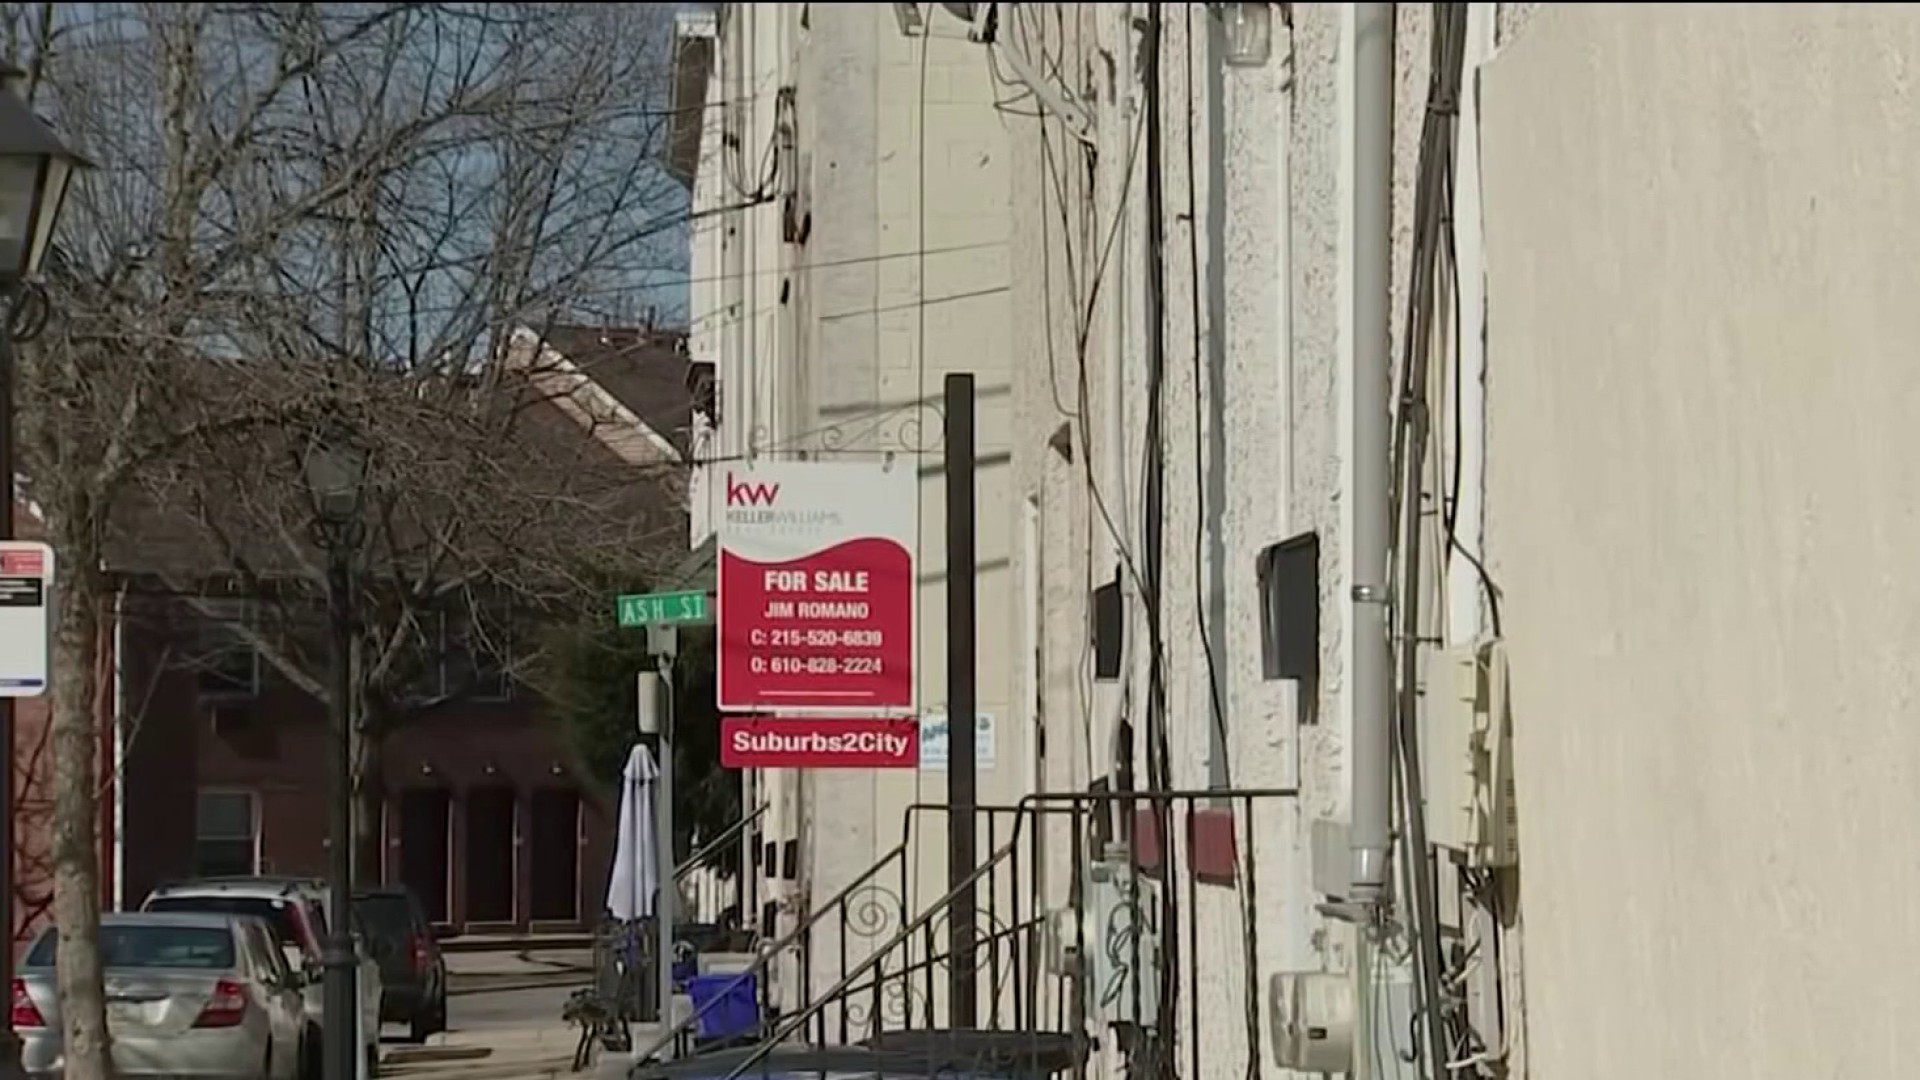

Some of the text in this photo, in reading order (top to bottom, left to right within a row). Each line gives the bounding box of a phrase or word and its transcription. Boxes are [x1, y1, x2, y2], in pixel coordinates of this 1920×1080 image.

[727, 471, 779, 506] kw
[765, 571, 868, 592] FOR SALE
[623, 598, 665, 623] ASH
[765, 602, 868, 618] JIM ROMANO
[751, 629, 767, 645] C:
[733, 731, 908, 756] Suburbs2City
